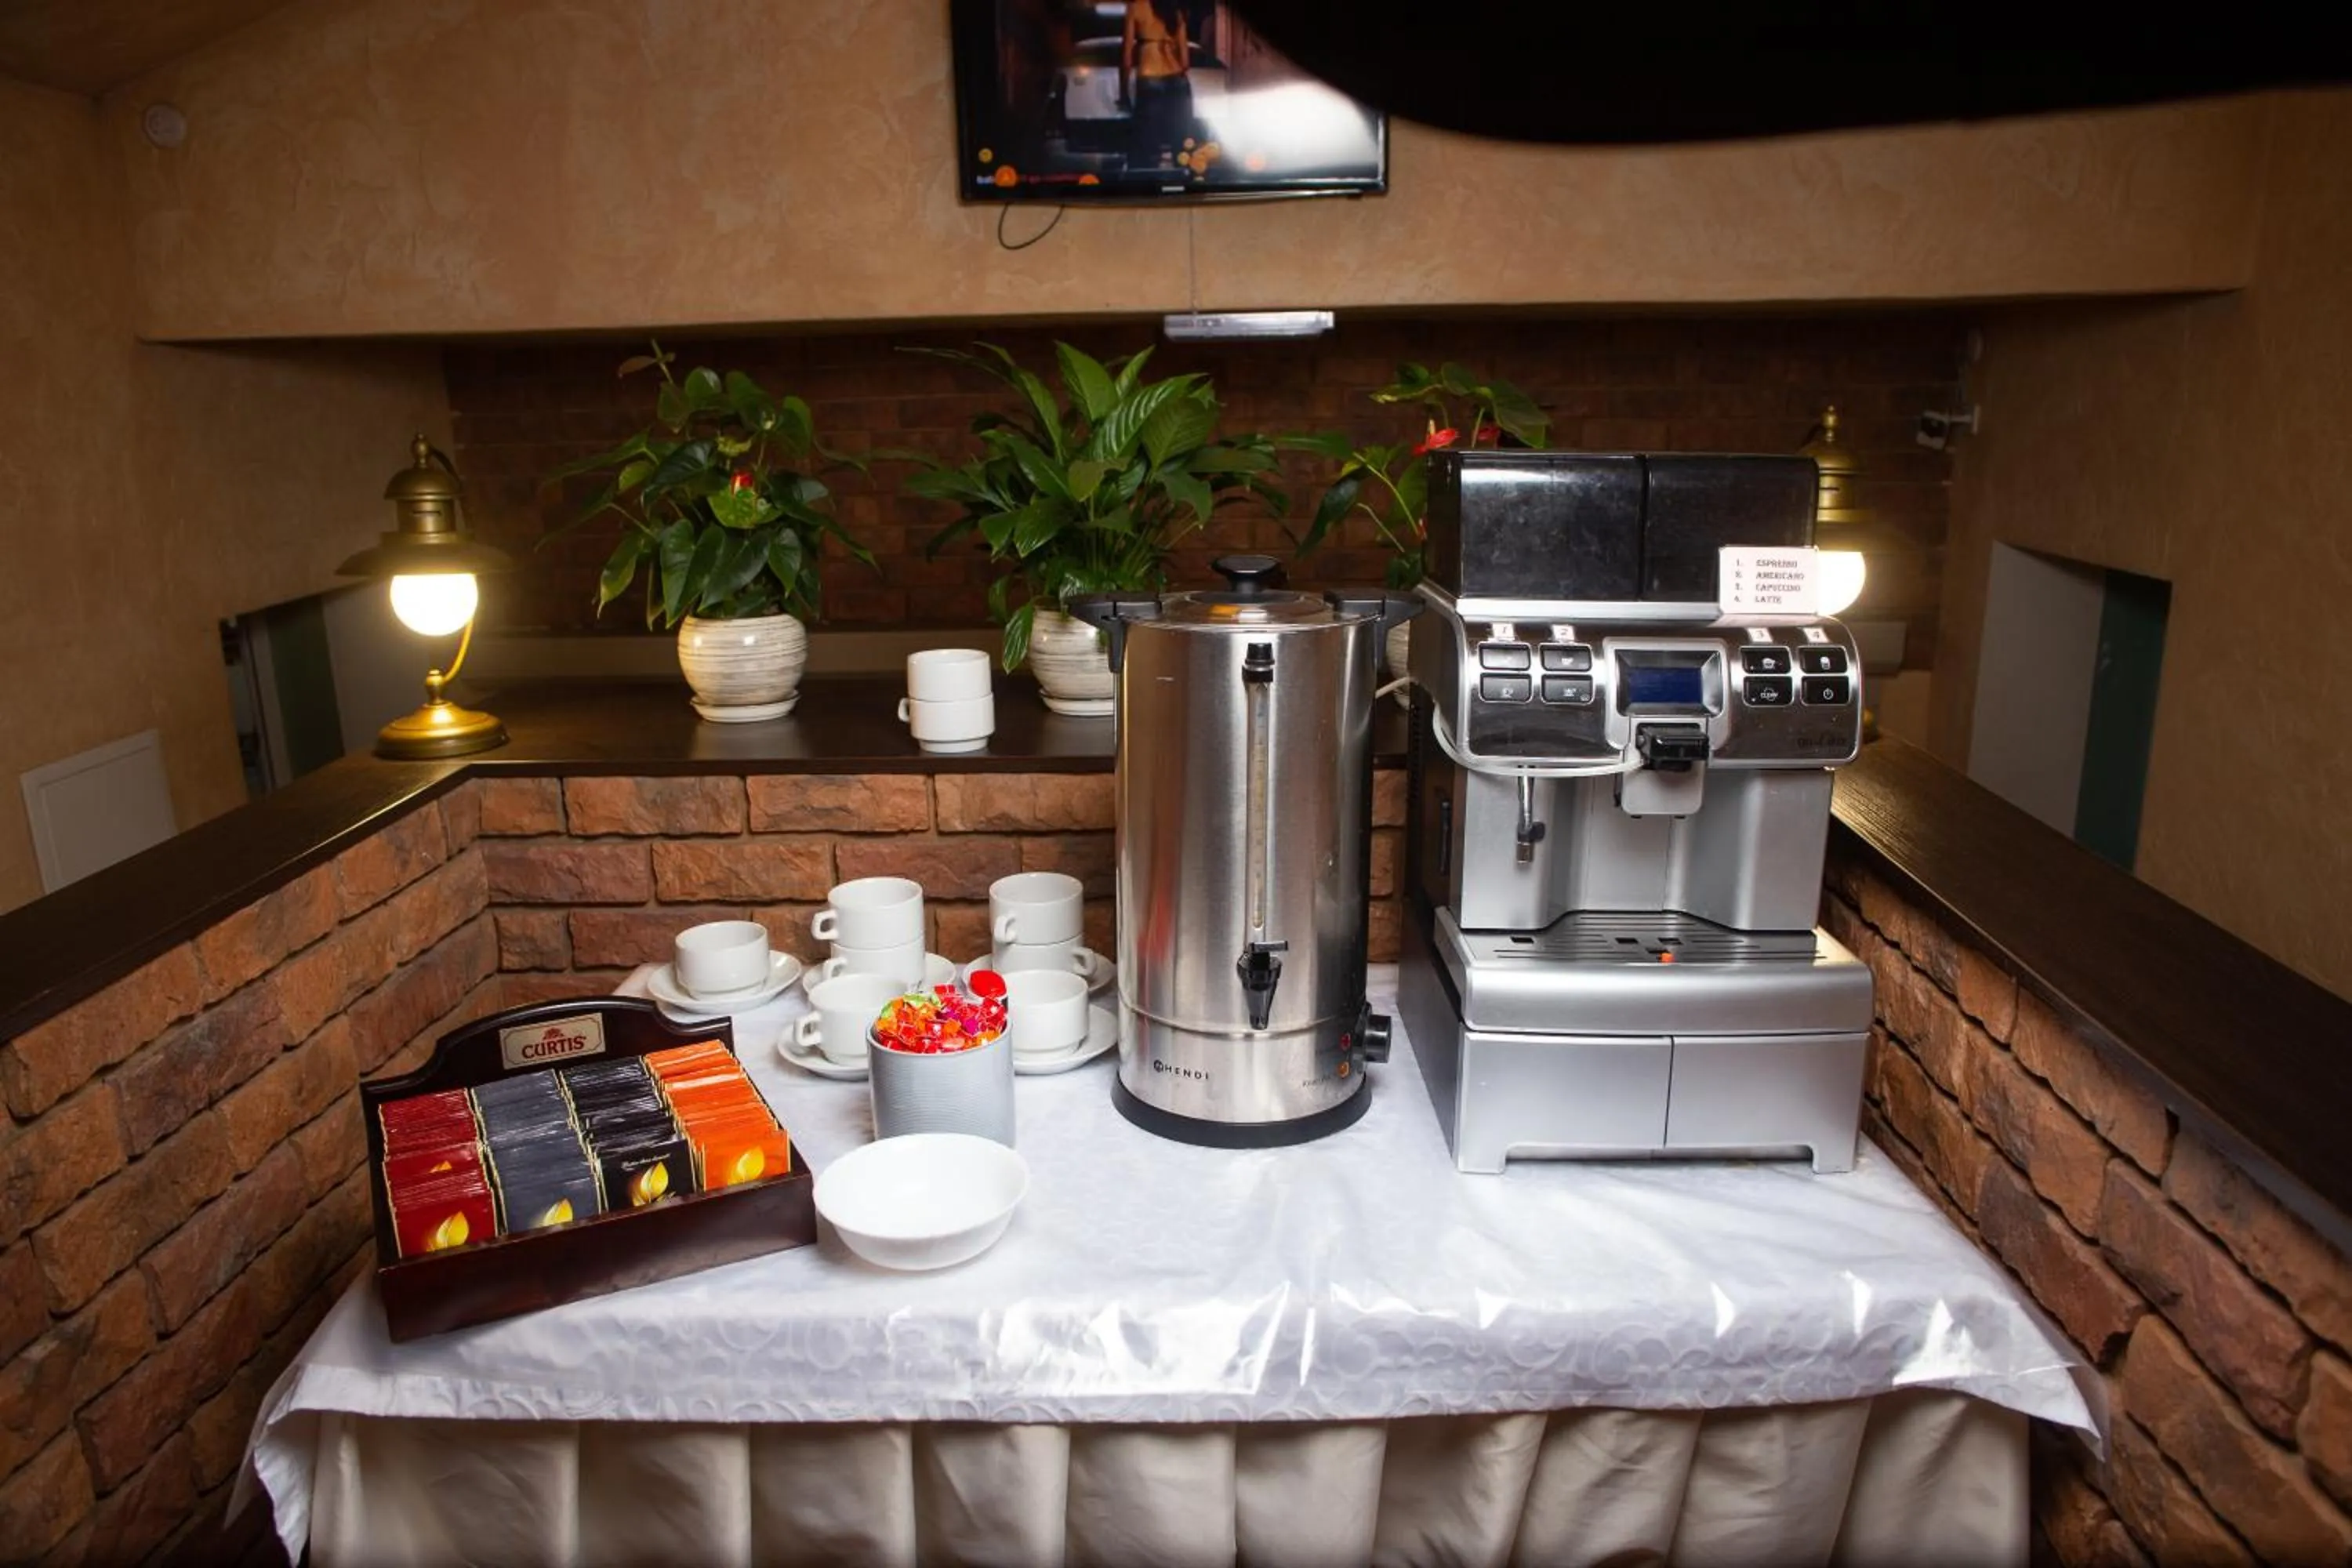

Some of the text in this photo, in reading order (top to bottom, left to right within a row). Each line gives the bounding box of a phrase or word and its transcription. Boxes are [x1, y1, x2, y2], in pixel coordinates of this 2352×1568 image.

[1755, 595, 1783, 604] LATTE
[521, 1036, 585, 1059] CURTIS
[1164, 1065, 1208, 1080] HENDI
